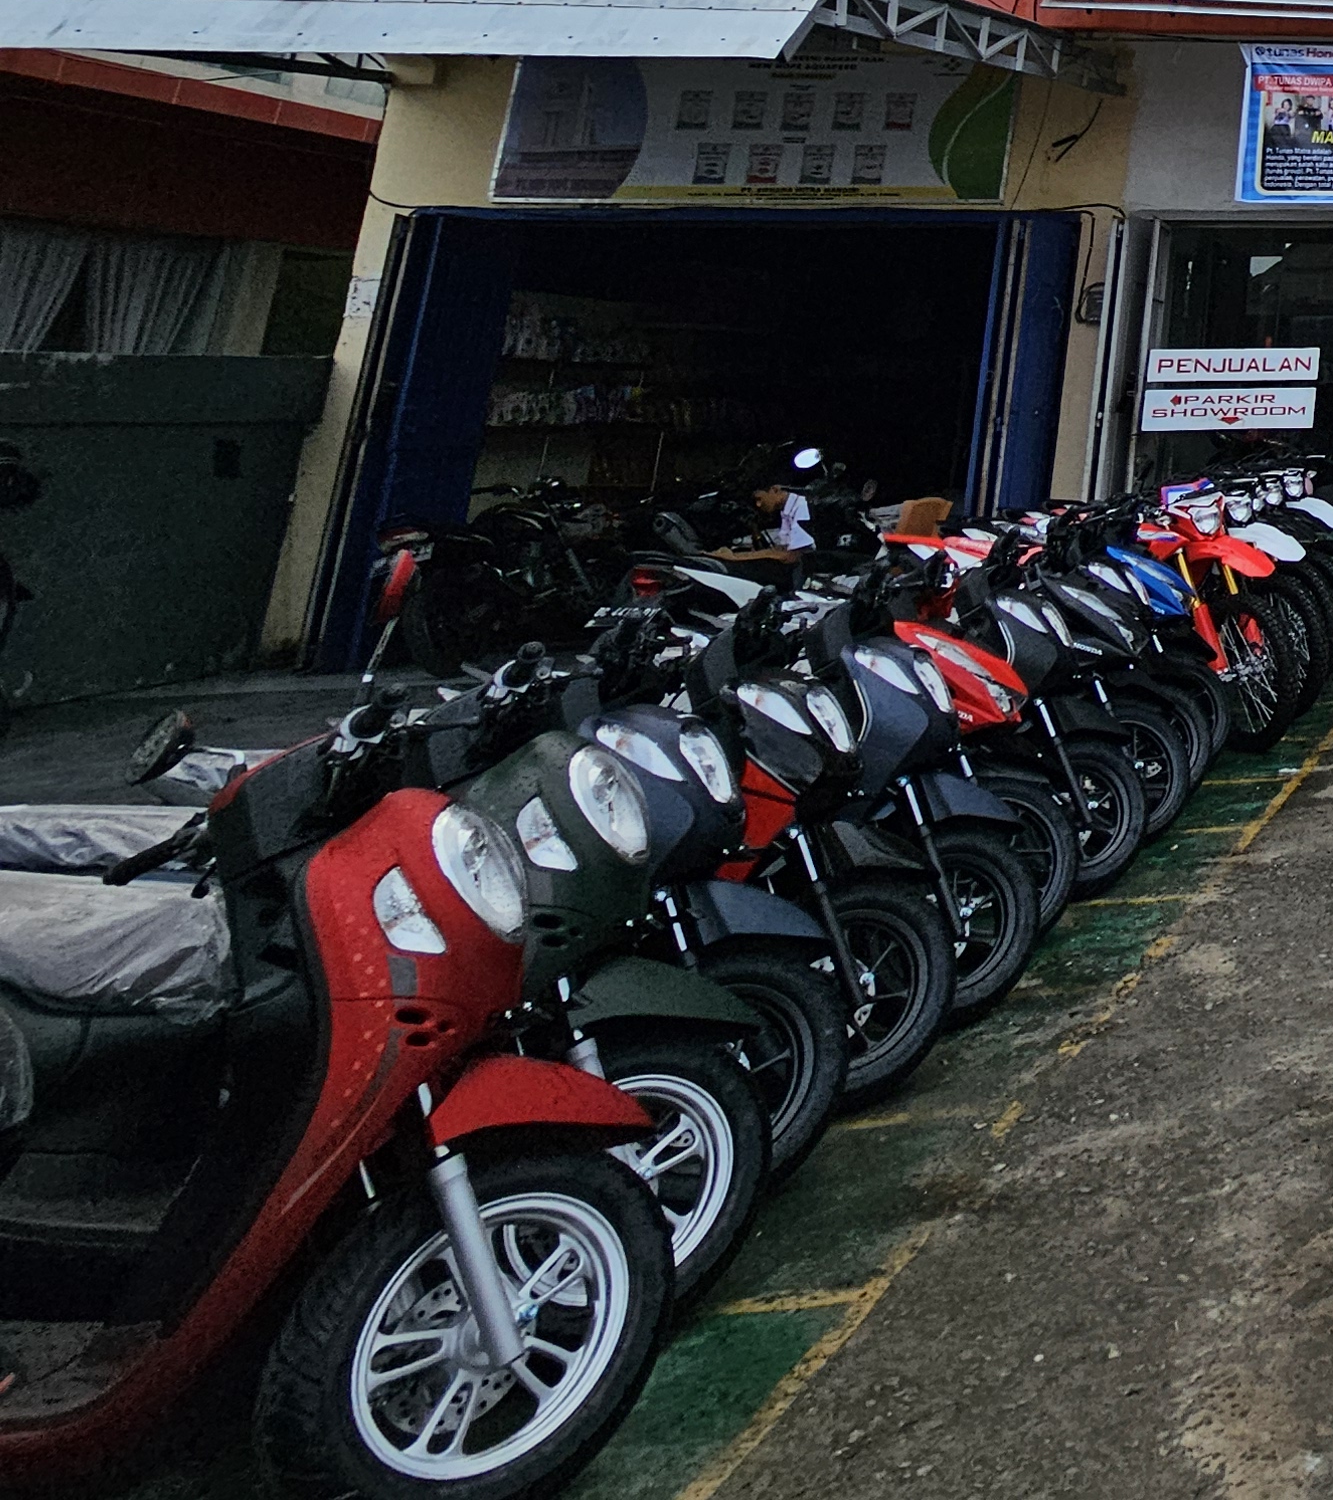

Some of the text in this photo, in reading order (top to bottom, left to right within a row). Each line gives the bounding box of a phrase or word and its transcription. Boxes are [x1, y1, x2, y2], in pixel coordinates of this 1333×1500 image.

[1273, 76, 1302, 87] TUNAS
[1157, 356, 1312, 374] PENJUALAN
[1184, 394, 1276, 405] PARKIR
[1151, 406, 1306, 418] SHOWROOM
